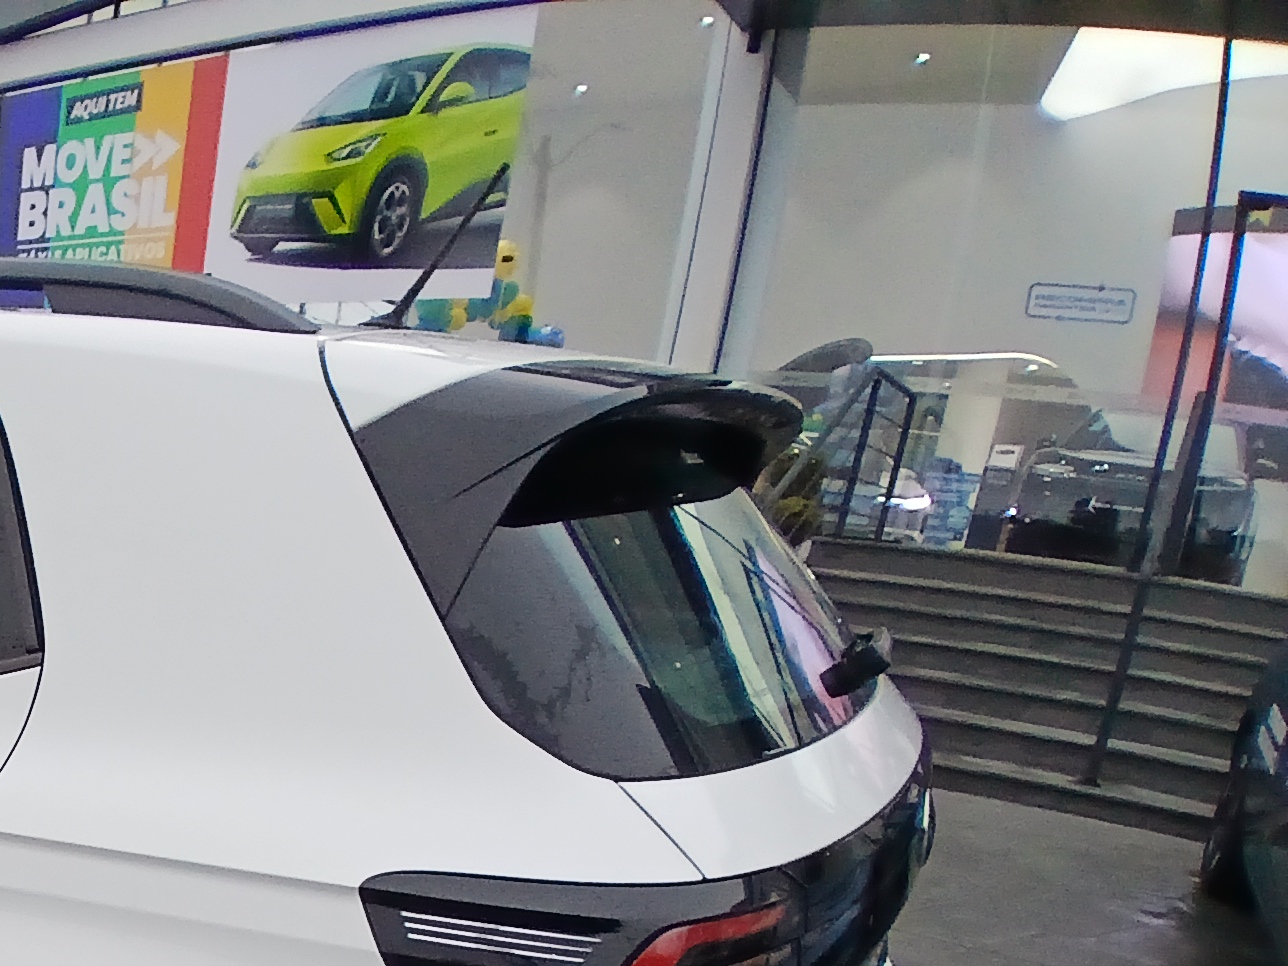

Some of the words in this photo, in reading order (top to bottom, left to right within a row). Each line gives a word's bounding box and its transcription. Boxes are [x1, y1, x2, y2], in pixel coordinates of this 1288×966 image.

[70, 97, 107, 119] AQUI
[108, 89, 138, 109] TEM
[21, 131, 134, 188] MOVE
[17, 175, 175, 241] BRASIL
